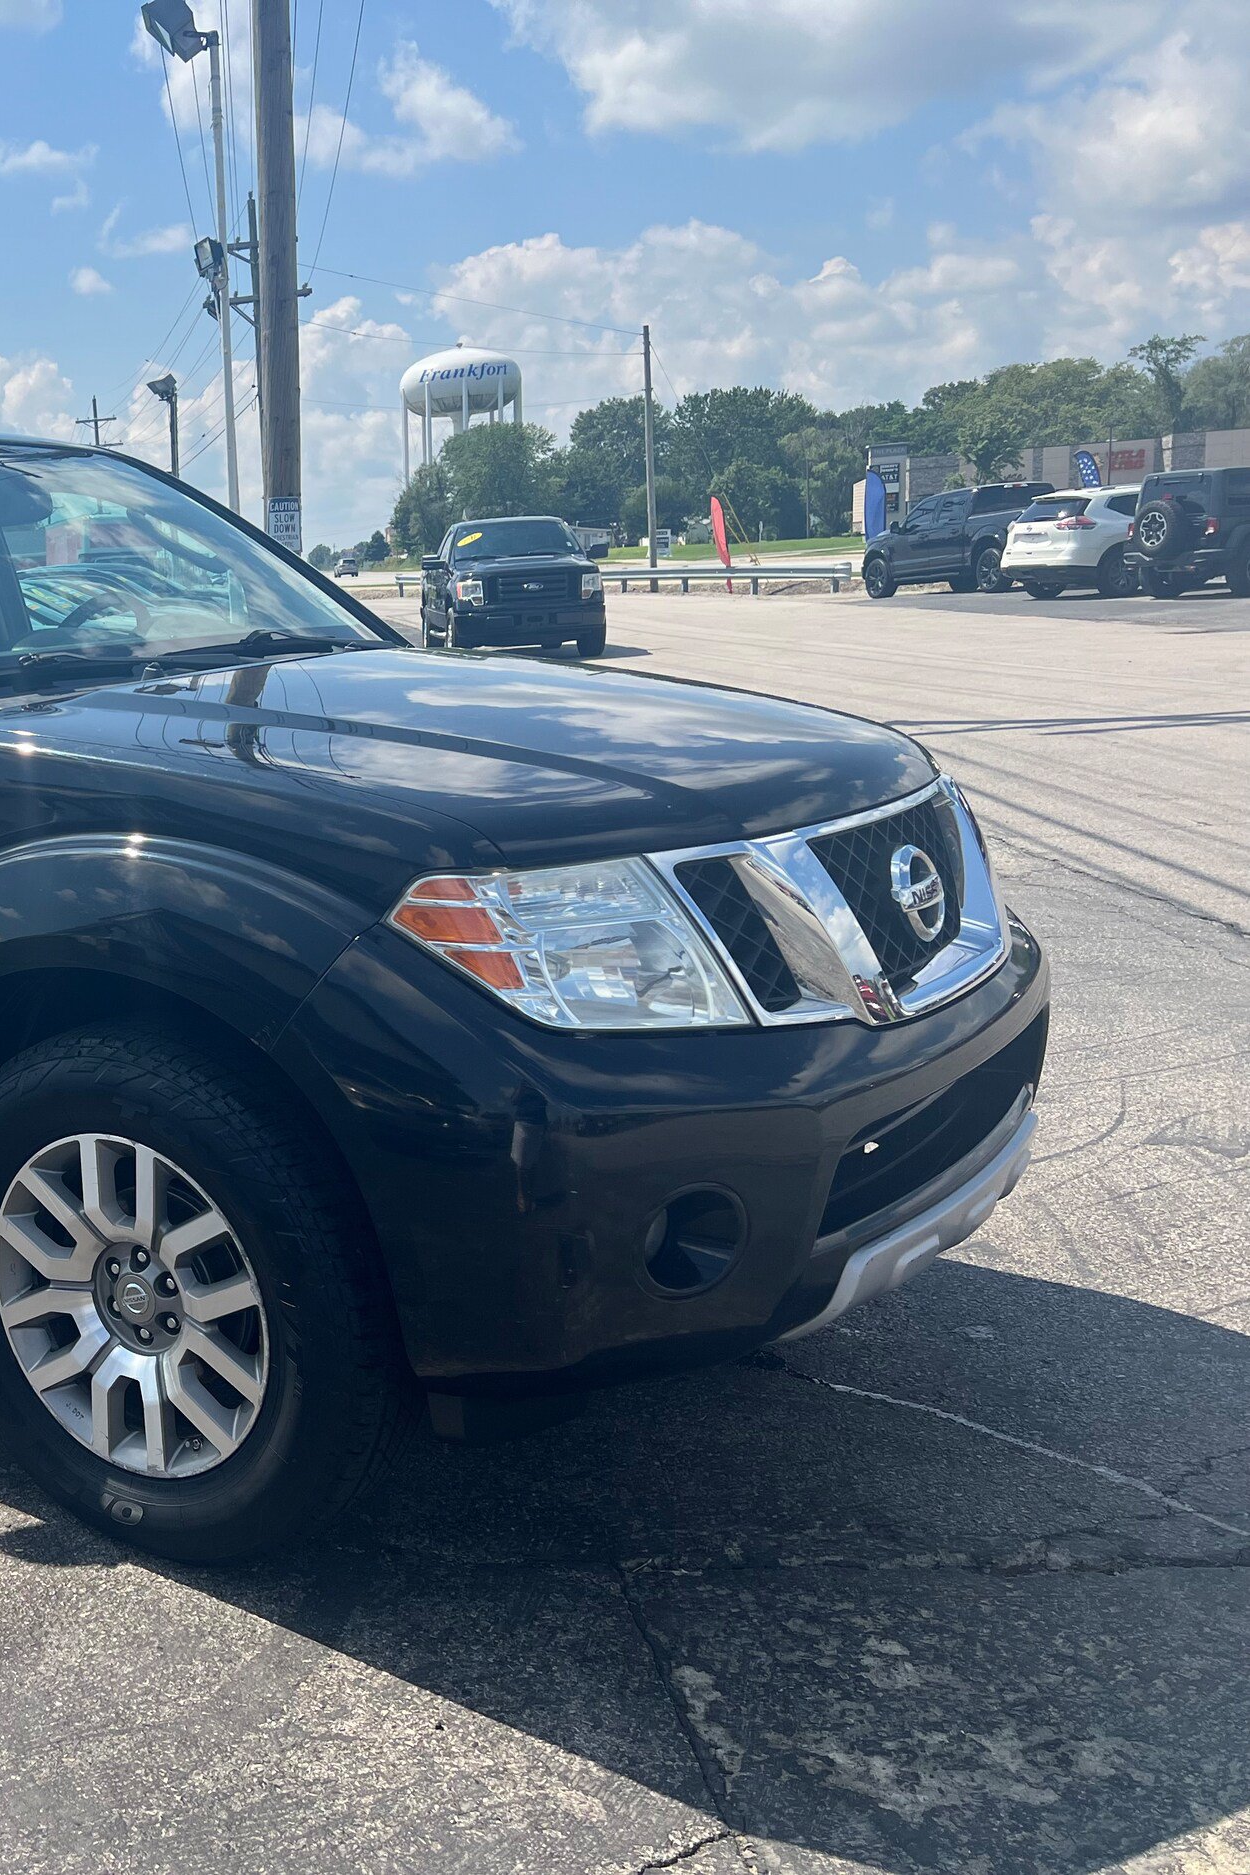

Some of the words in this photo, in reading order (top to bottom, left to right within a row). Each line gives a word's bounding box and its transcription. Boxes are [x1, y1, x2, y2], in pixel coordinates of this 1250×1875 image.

[419, 362, 508, 384] Frankfort
[270, 501, 298, 511] CAUTION
[274, 513, 295, 523] SLOW
[274, 524, 296, 533] DOWN
[123, 1295, 146, 1303] NISSAN
